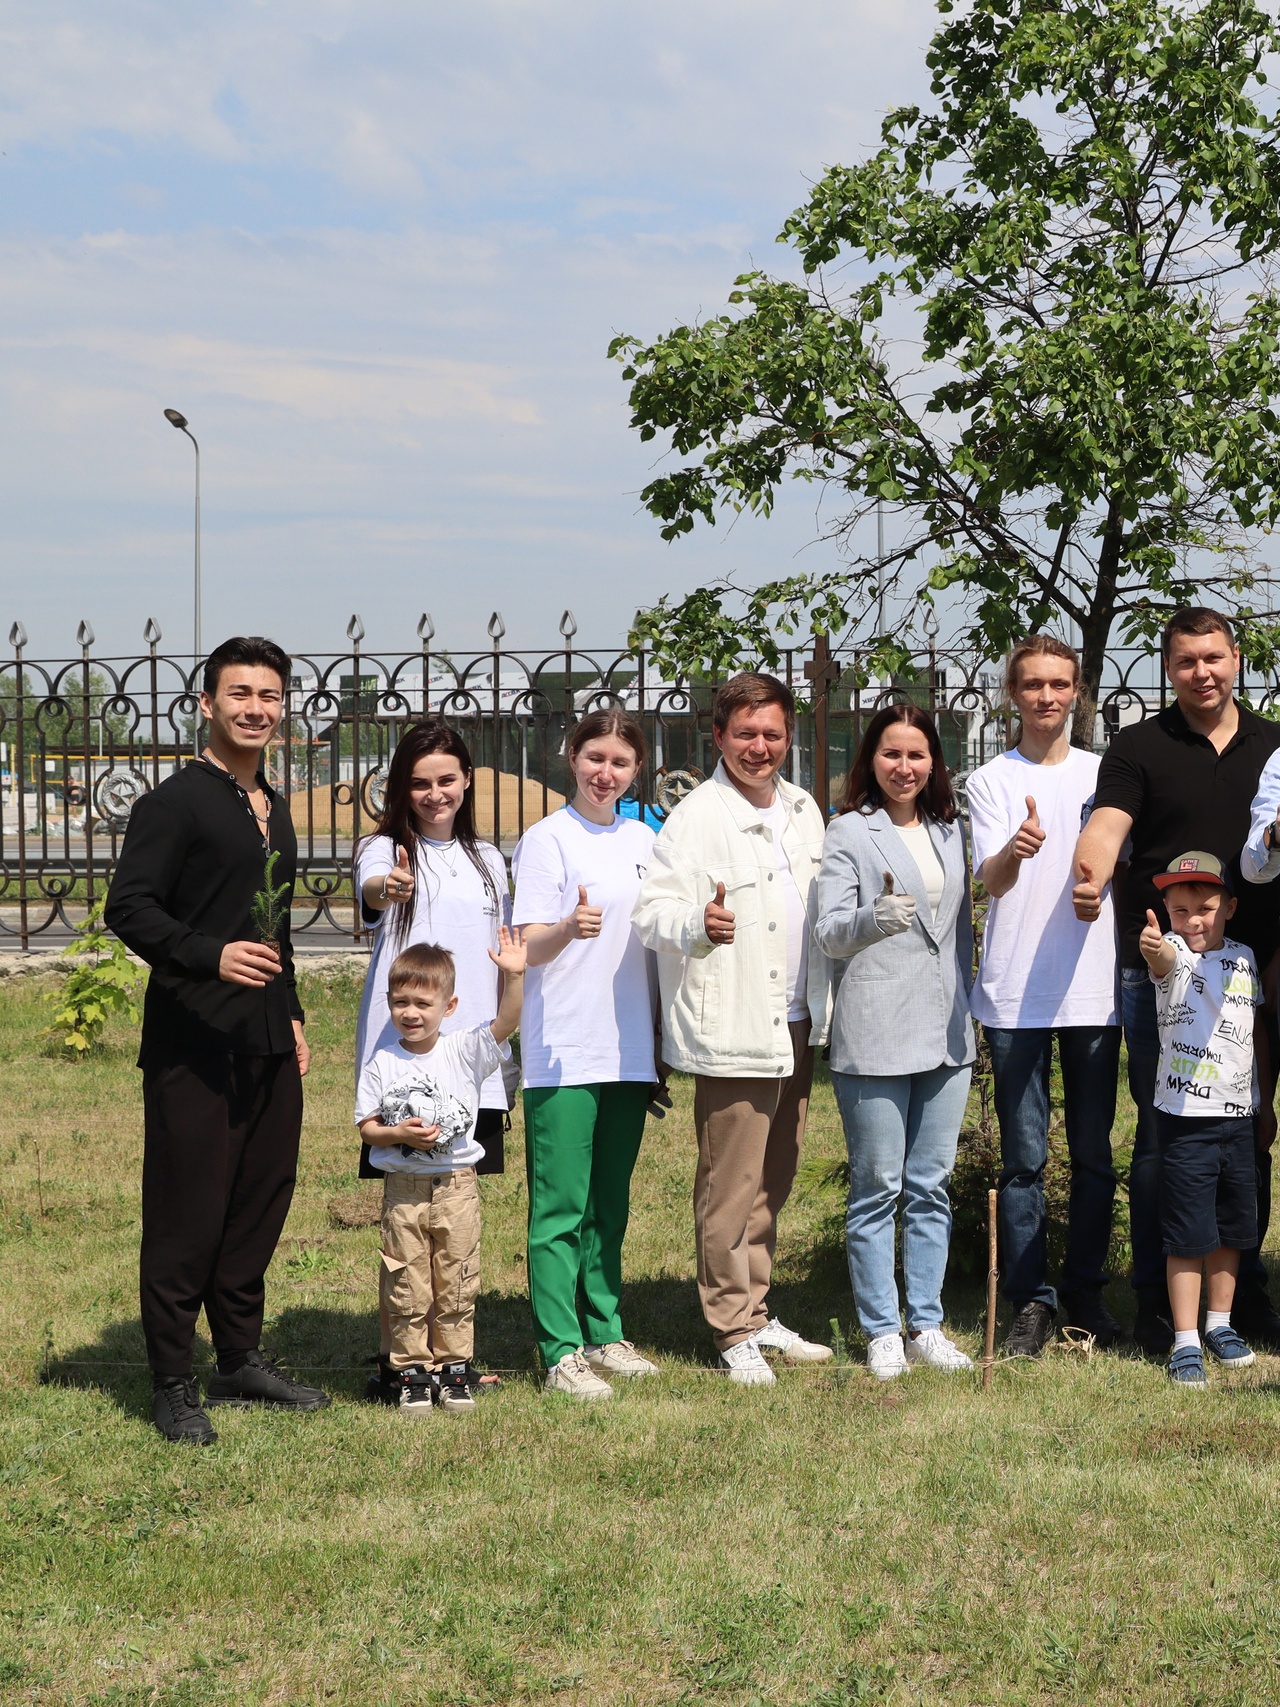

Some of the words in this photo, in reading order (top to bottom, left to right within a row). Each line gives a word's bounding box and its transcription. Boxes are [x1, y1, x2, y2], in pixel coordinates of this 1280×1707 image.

[1171, 1039, 1223, 1065] TOMORROW
[1170, 1055, 1219, 1081] YOUR
[1167, 1075, 1211, 1099] DRAW
